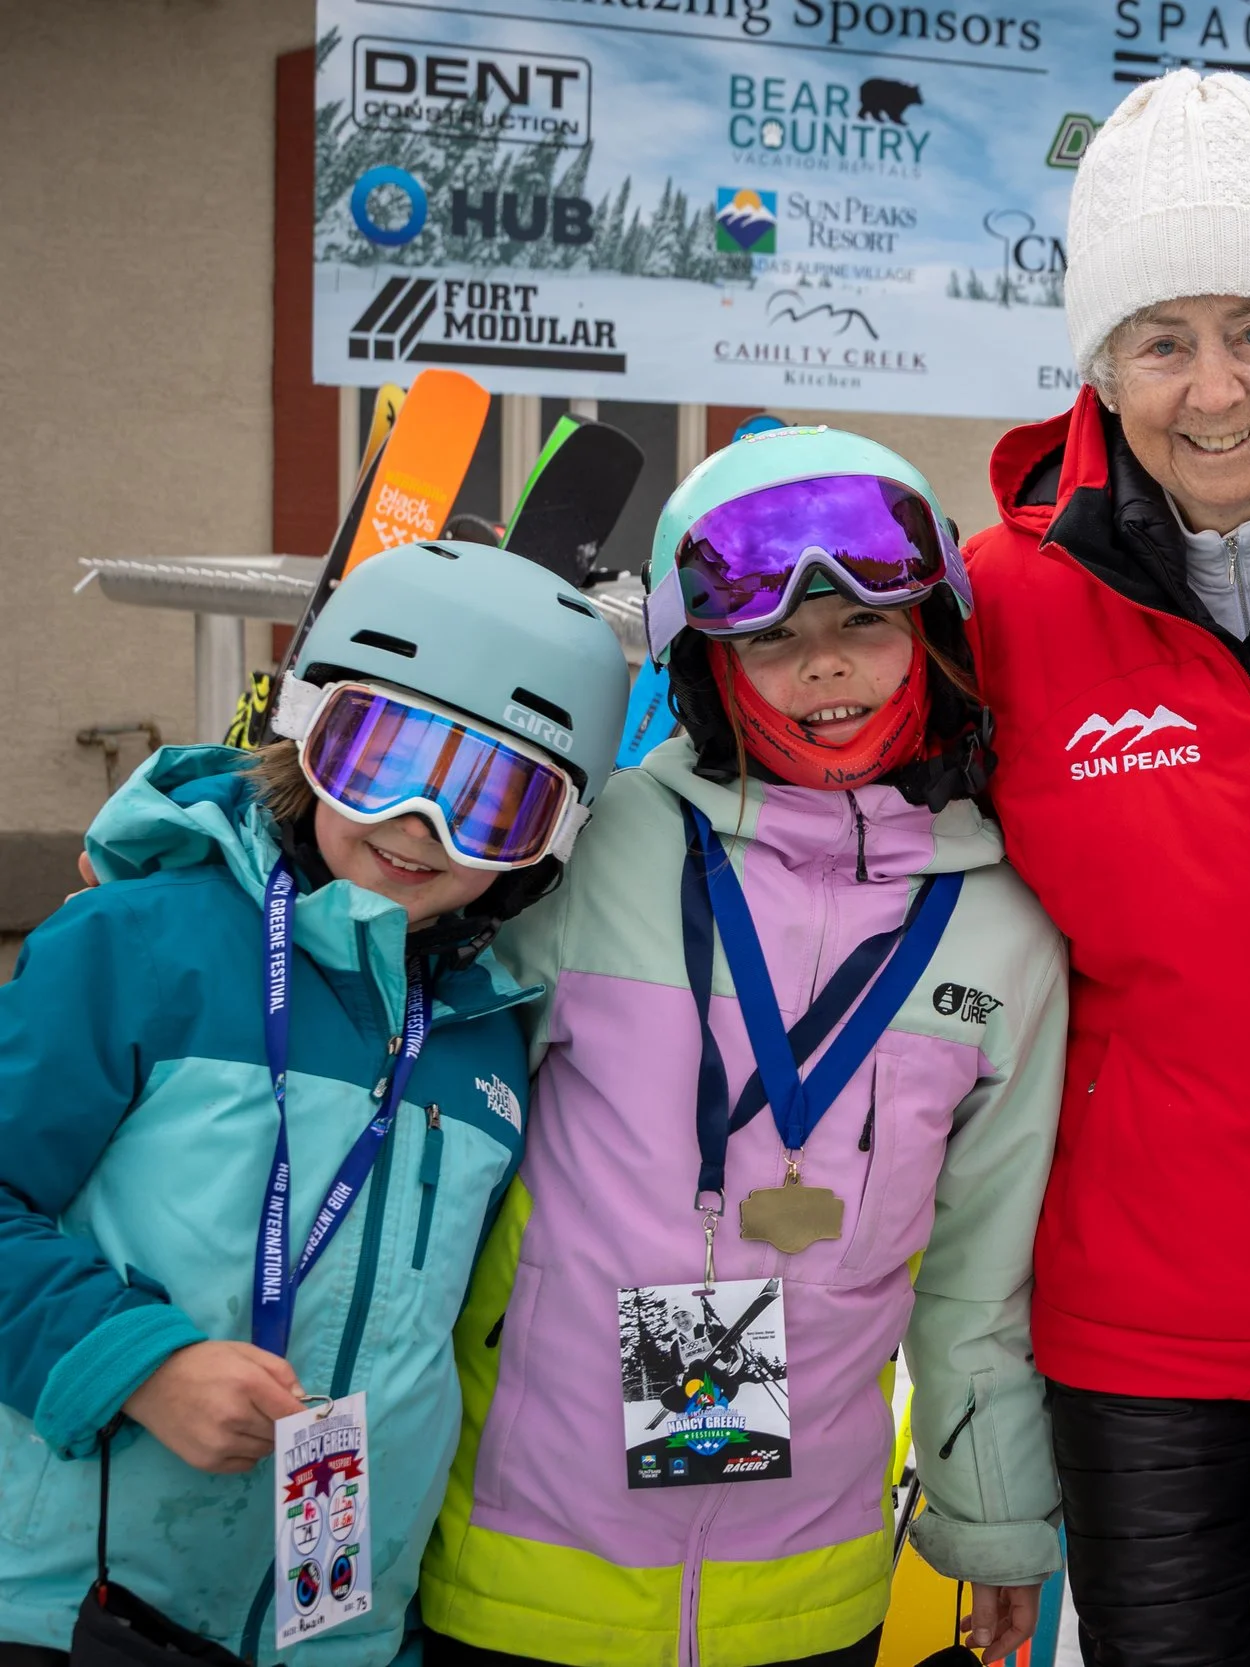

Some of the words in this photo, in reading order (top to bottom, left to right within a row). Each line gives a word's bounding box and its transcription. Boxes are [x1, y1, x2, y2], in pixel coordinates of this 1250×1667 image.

[793, 0, 1042, 51] Sponsors
[364, 48, 580, 110] DENT
[730, 74, 850, 119] BEAR
[363, 101, 579, 136] CONSTRUCTION
[728, 113, 931, 164] COUNTRY
[732, 152, 830, 172] VACATION
[839, 160, 922, 180] RENTALS
[450, 188, 595, 245] HUB
[787, 192, 840, 224] SUN
[846, 197, 917, 230] PEAKS
[807, 222, 899, 254] RESORT
[850, 264, 917, 283] VILLAGE
[443, 280, 539, 313] FORT
[443, 312, 618, 348] MODULAR
[714, 340, 832, 366] CAHILTY
[843, 346, 929, 370] CREEK
[783, 369, 862, 389] Kitchen
[380, 484, 430, 514] black
[375, 500, 436, 533] crows
[502, 704, 574, 754] GIRO
[1070, 756, 1118, 781] SUN
[1123, 744, 1201, 773] PEAKS
[270, 870, 295, 896] NANCY
[269, 898, 287, 951] GREENE
[269, 952, 286, 1015] FESTIVAL
[405, 1012, 425, 1060] FESTIVAL
[272, 1162, 290, 1192] HUB
[326, 1181, 353, 1211] HUB
[261, 1196, 284, 1305] INTERNATIONAL
[668, 1417, 704, 1433] NANCY
[705, 1416, 747, 1430] GREENE
[691, 1430, 725, 1439] FESTIVAL
[722, 1461, 770, 1474] RACERS
